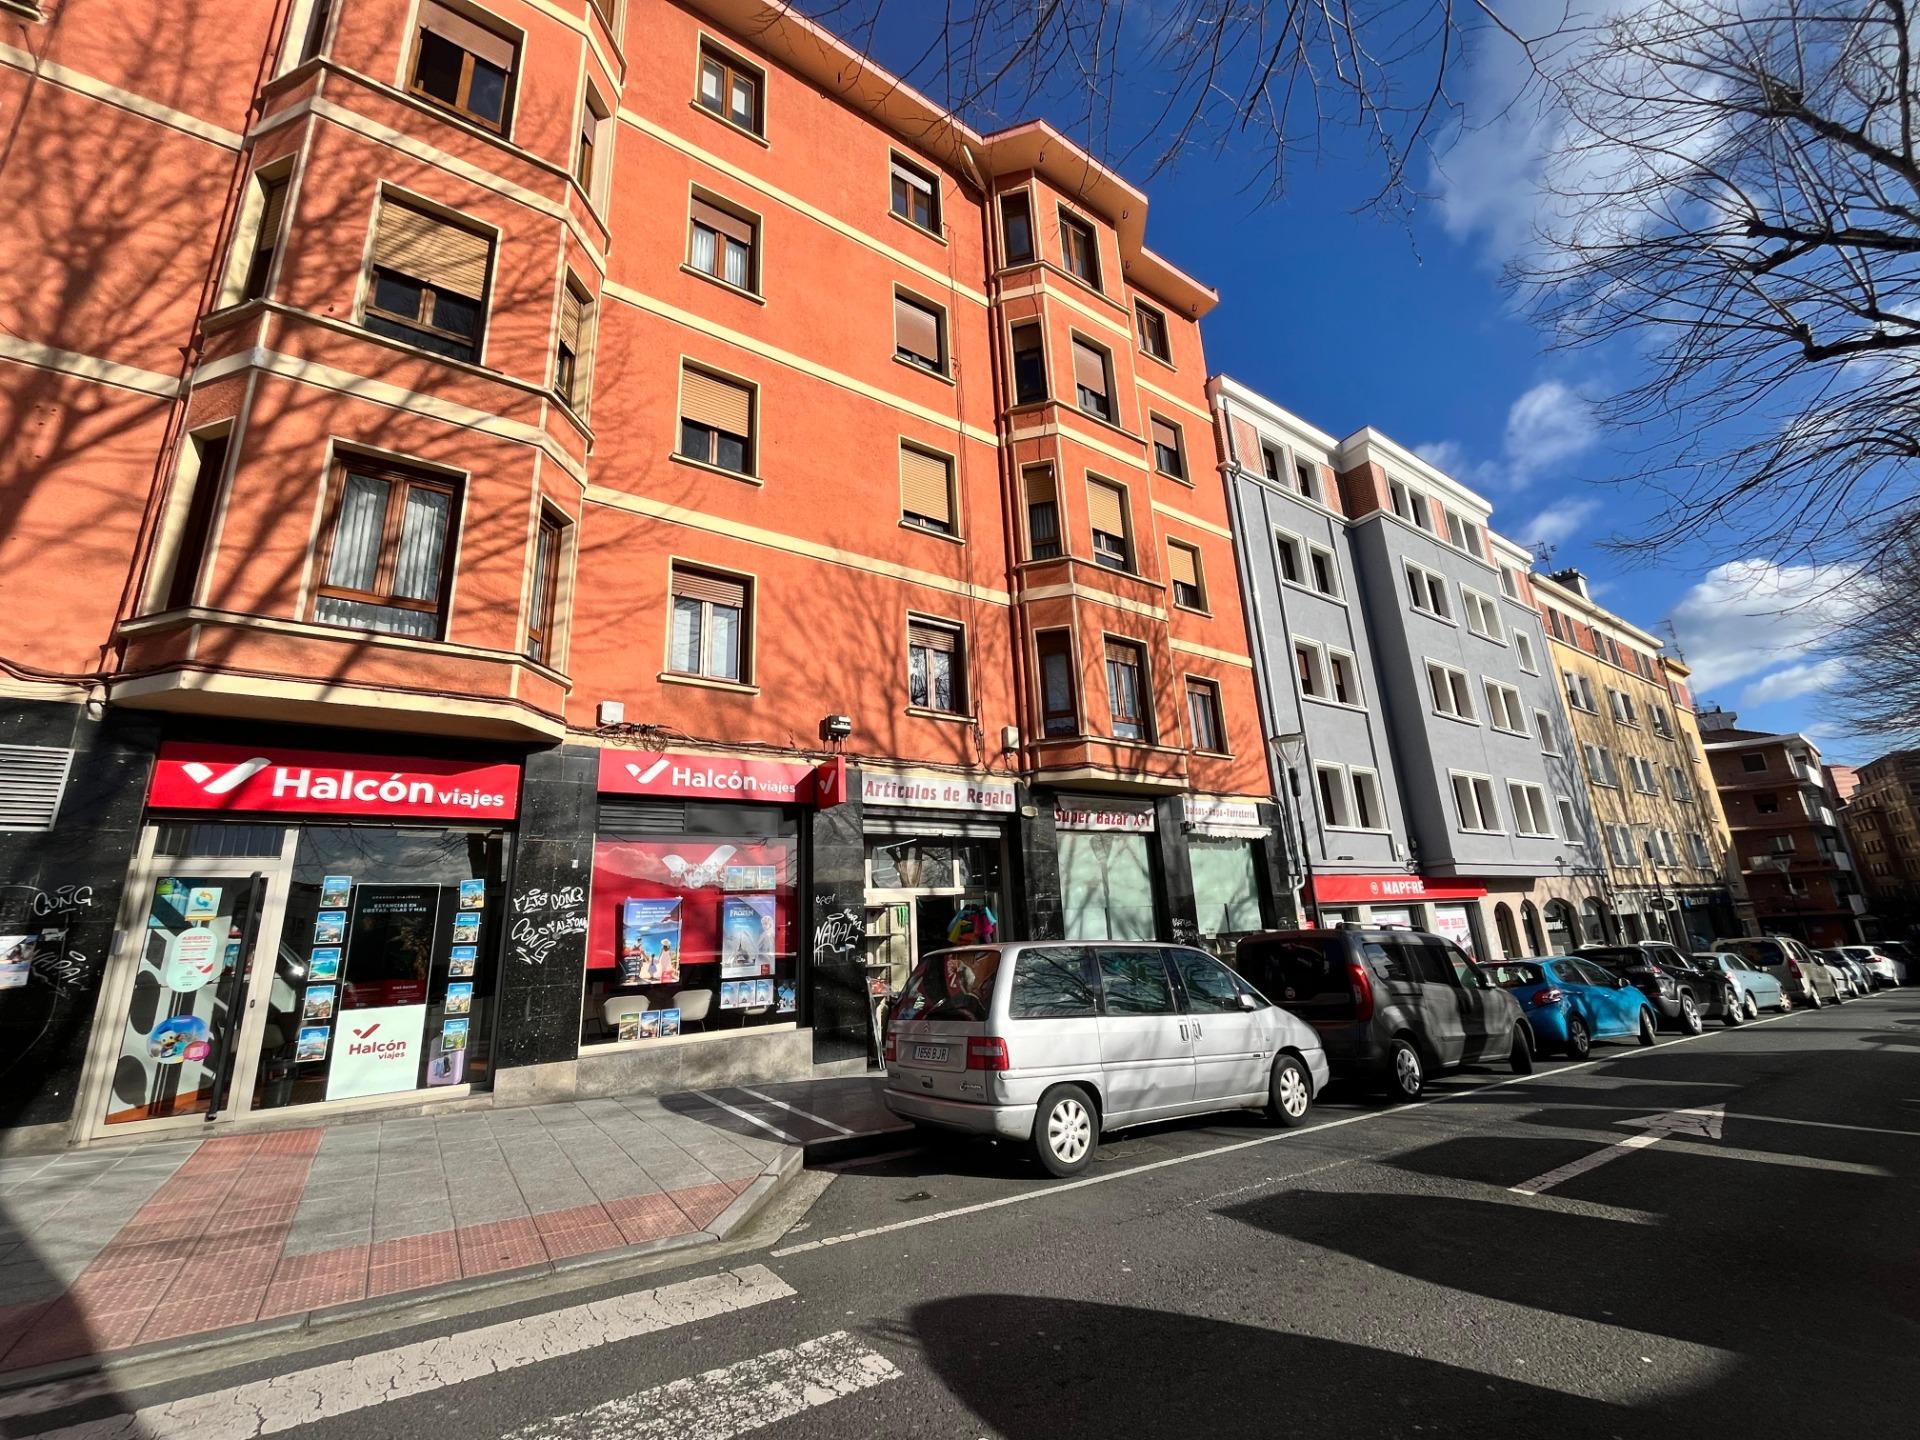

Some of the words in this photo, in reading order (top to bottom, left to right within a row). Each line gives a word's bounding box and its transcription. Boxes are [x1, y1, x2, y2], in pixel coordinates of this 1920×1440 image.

[271, 767, 434, 804] Halcón
[437, 788, 504, 809] viajes
[671, 766, 757, 790] Halcón
[759, 780, 796, 794] viajes
[943, 786, 960, 802] de
[966, 787, 1013, 807] Regalo
[1055, 808, 1091, 826] Super
[1096, 809, 1129, 826] Bazar
[1382, 879, 1426, 895] MAPFRE
[348, 1039, 407, 1055] Halcón
[378, 1051, 405, 1060] viajes
